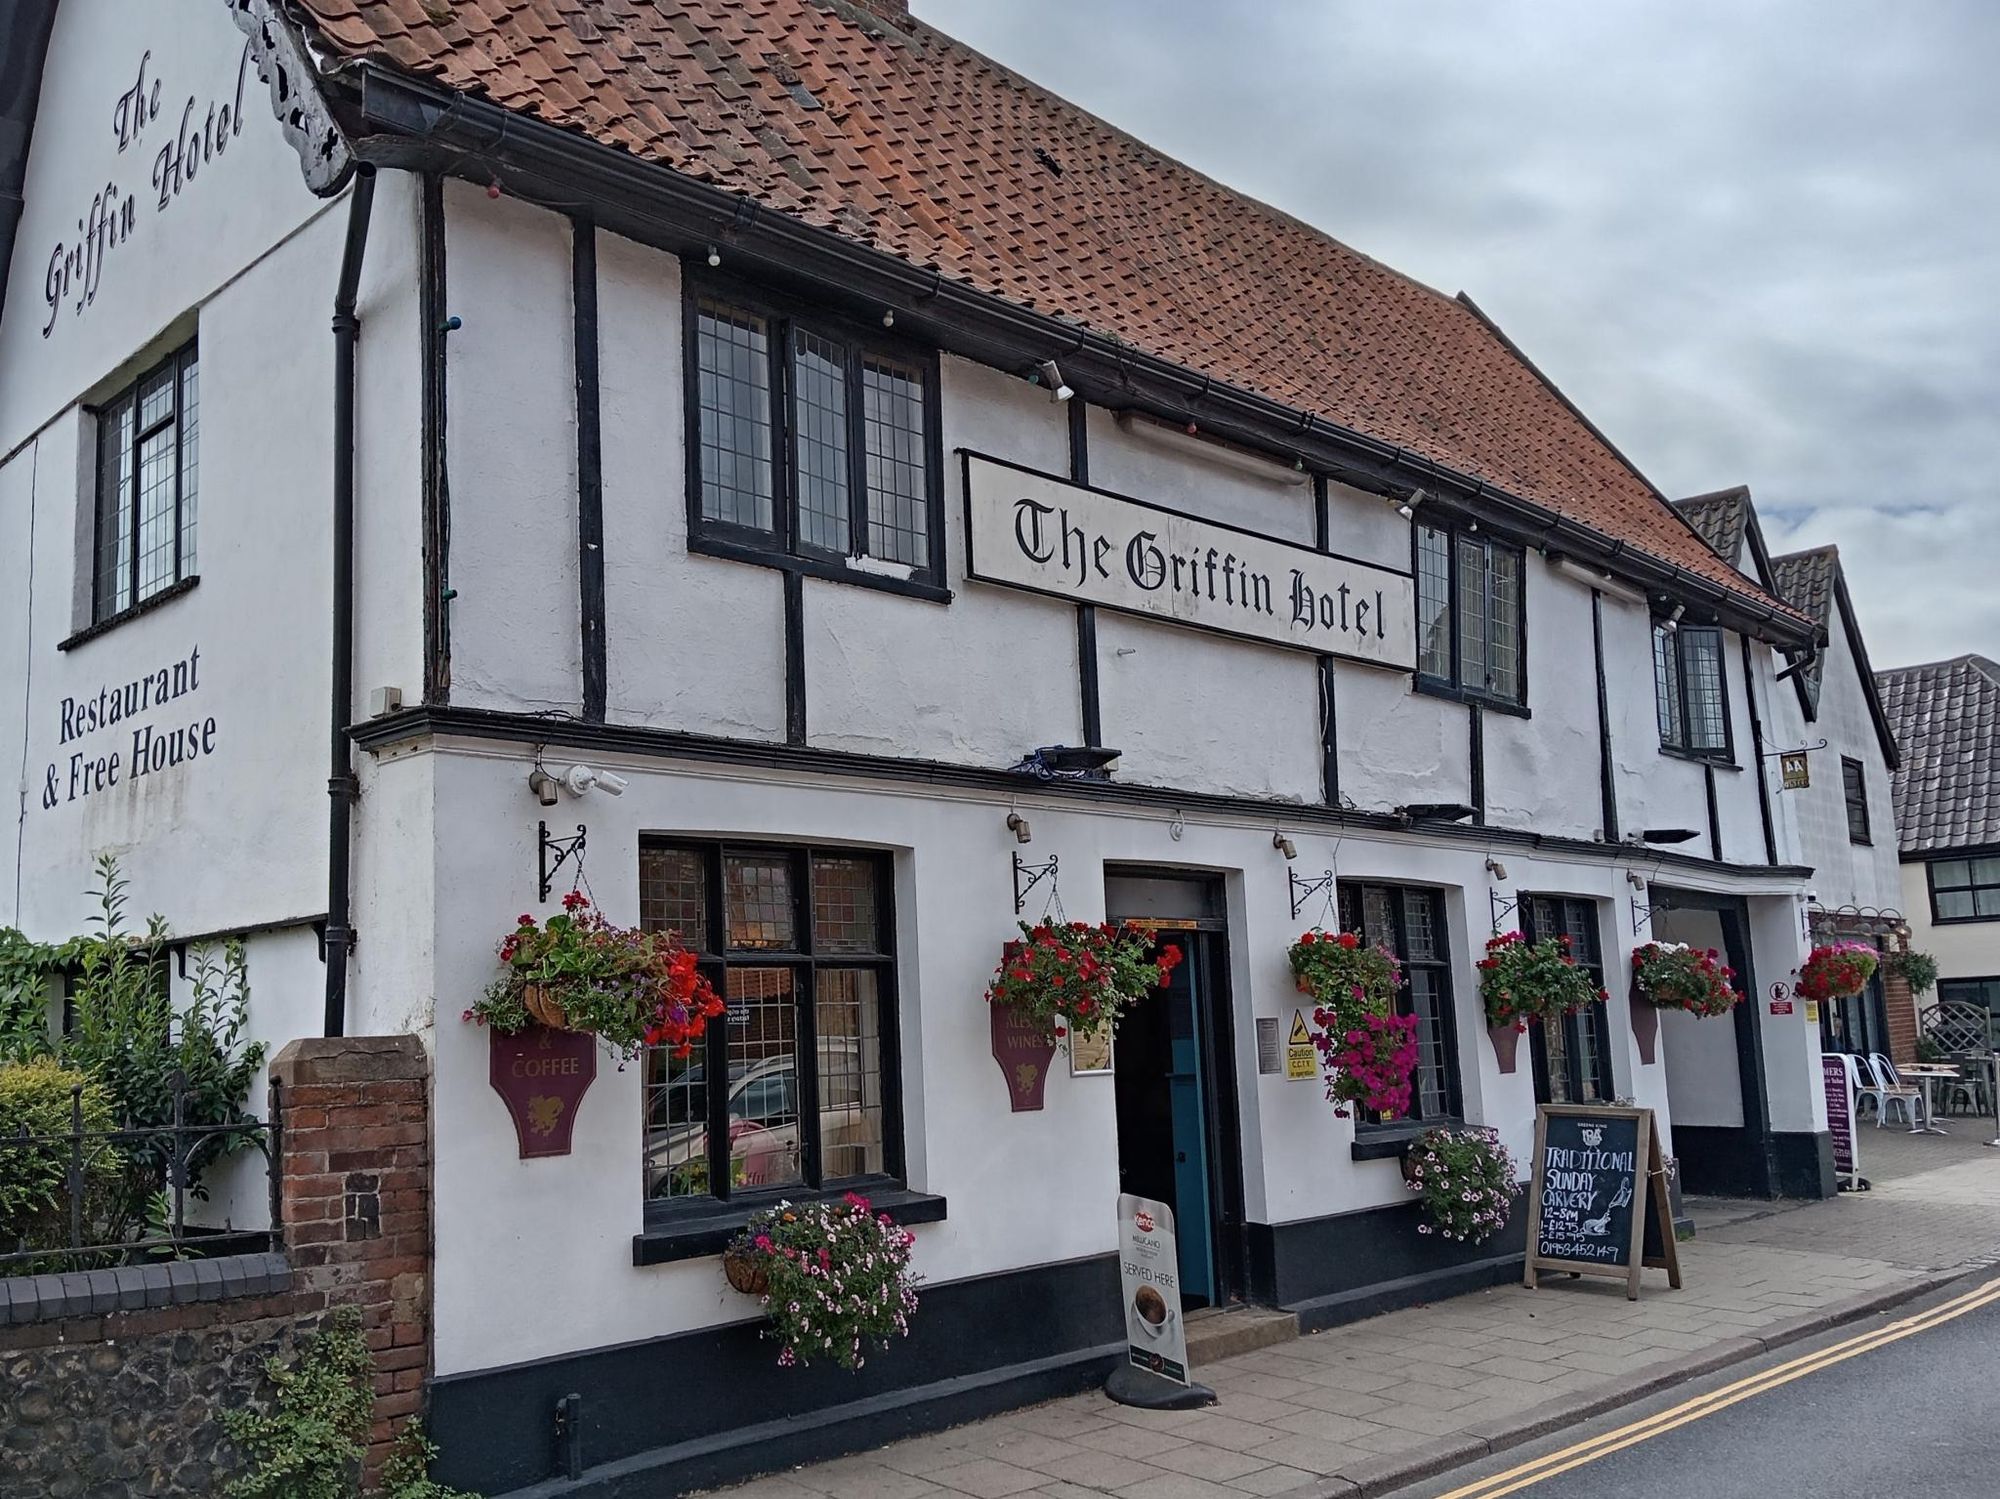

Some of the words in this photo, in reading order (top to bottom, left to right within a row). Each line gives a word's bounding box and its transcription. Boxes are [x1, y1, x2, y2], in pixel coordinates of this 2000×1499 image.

[114, 50, 162, 154] The
[43, 181, 135, 339] Griffin
[153, 38, 250, 212] Hotel
[1013, 498, 1111, 589] The
[1126, 530, 1275, 616] Griffin
[1288, 568, 1386, 640] Hotel
[59, 643, 200, 745] Restaurant
[42, 763, 59, 810] &
[67, 752, 120, 802] Free
[129, 716, 216, 779] House
[1785, 760, 1804, 773] AA
[1288, 1048, 1314, 1057] Caution
[511, 1057, 580, 1078] COFFEE
[1546, 1147, 1635, 1173] TRADITIONAL
[1546, 1169, 1597, 1192] SUNDAY
[1542, 1190, 1598, 1211] CARVERY
[1135, 1213, 1155, 1228] Kenco
[1124, 1262, 1152, 1281] SERVED
[1154, 1270, 1175, 1288] HERE
